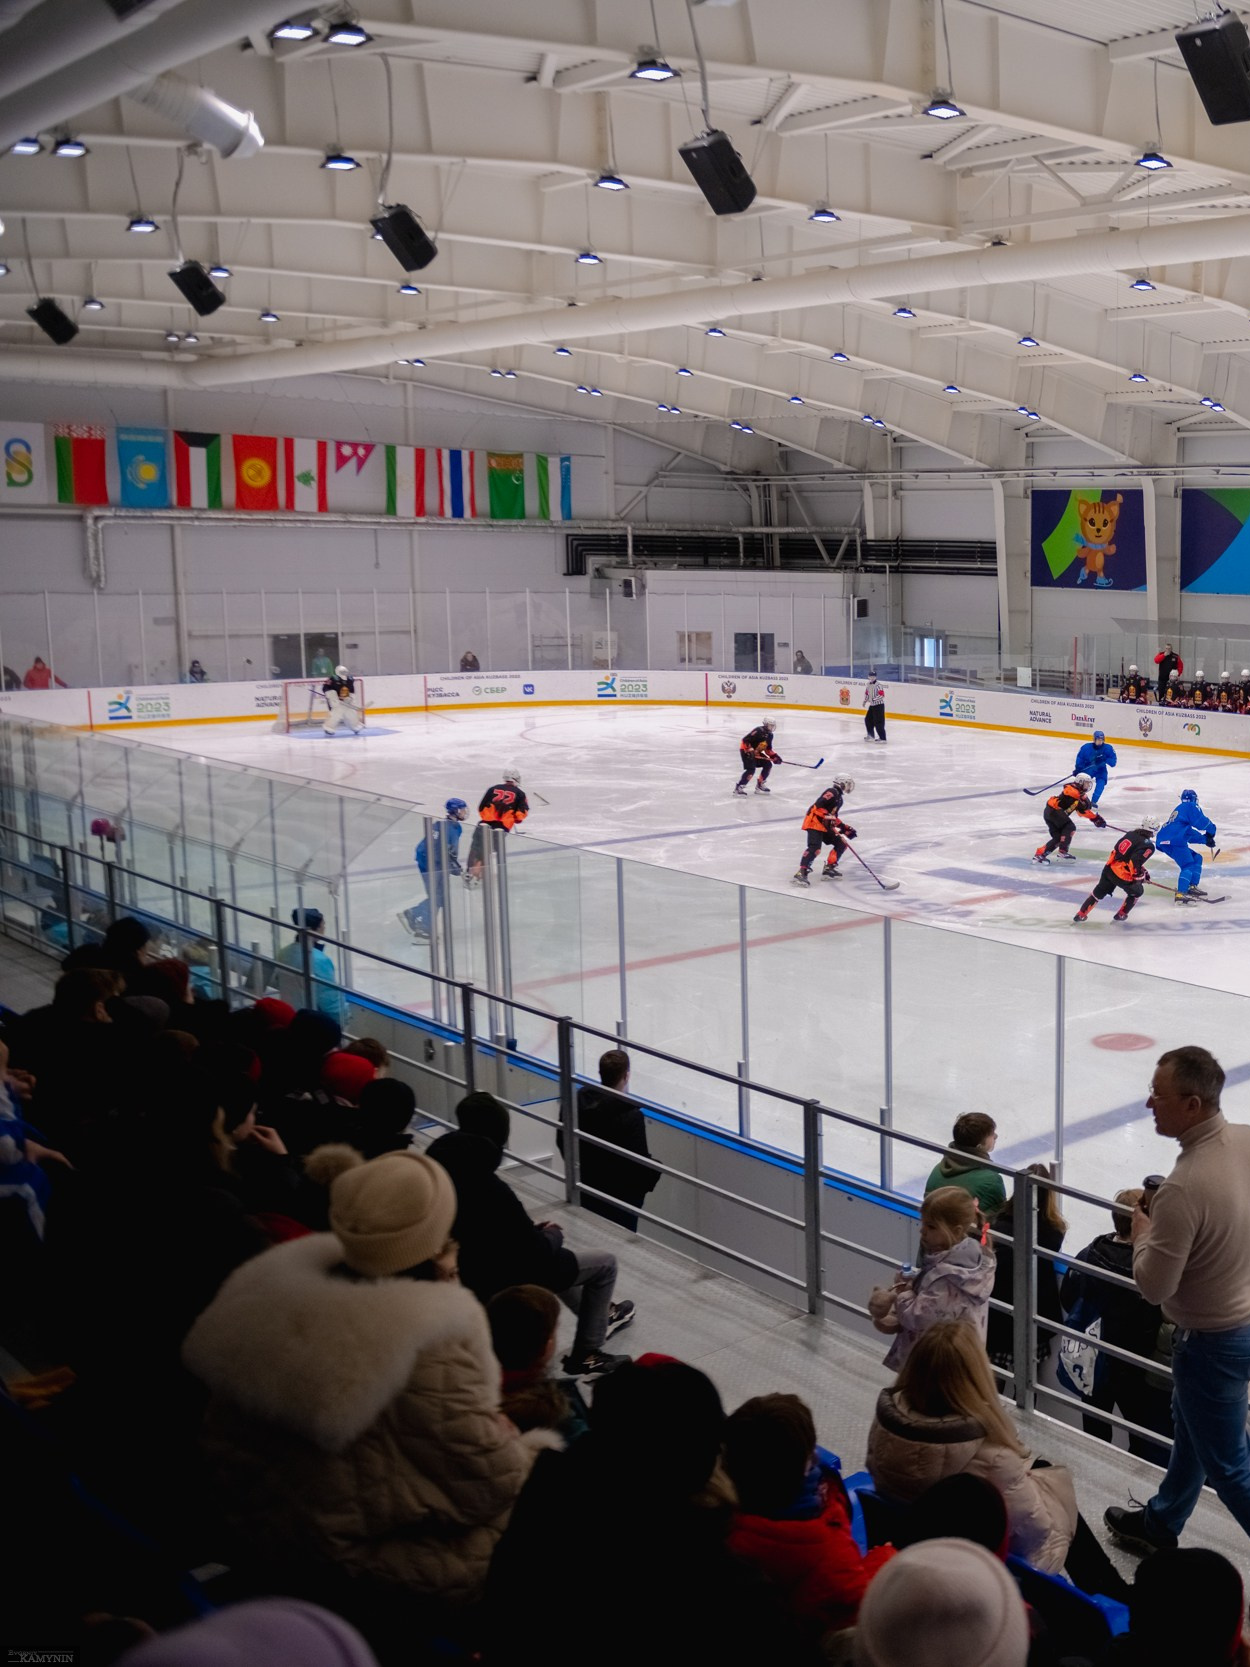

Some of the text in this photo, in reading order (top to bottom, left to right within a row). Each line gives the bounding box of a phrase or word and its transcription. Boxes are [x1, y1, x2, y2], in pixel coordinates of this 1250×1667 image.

[484, 686, 507, 694] СБЕР
[620, 684, 648, 692] 2023
[136, 702, 171, 713] 2023
[955, 703, 976, 714] 2023
